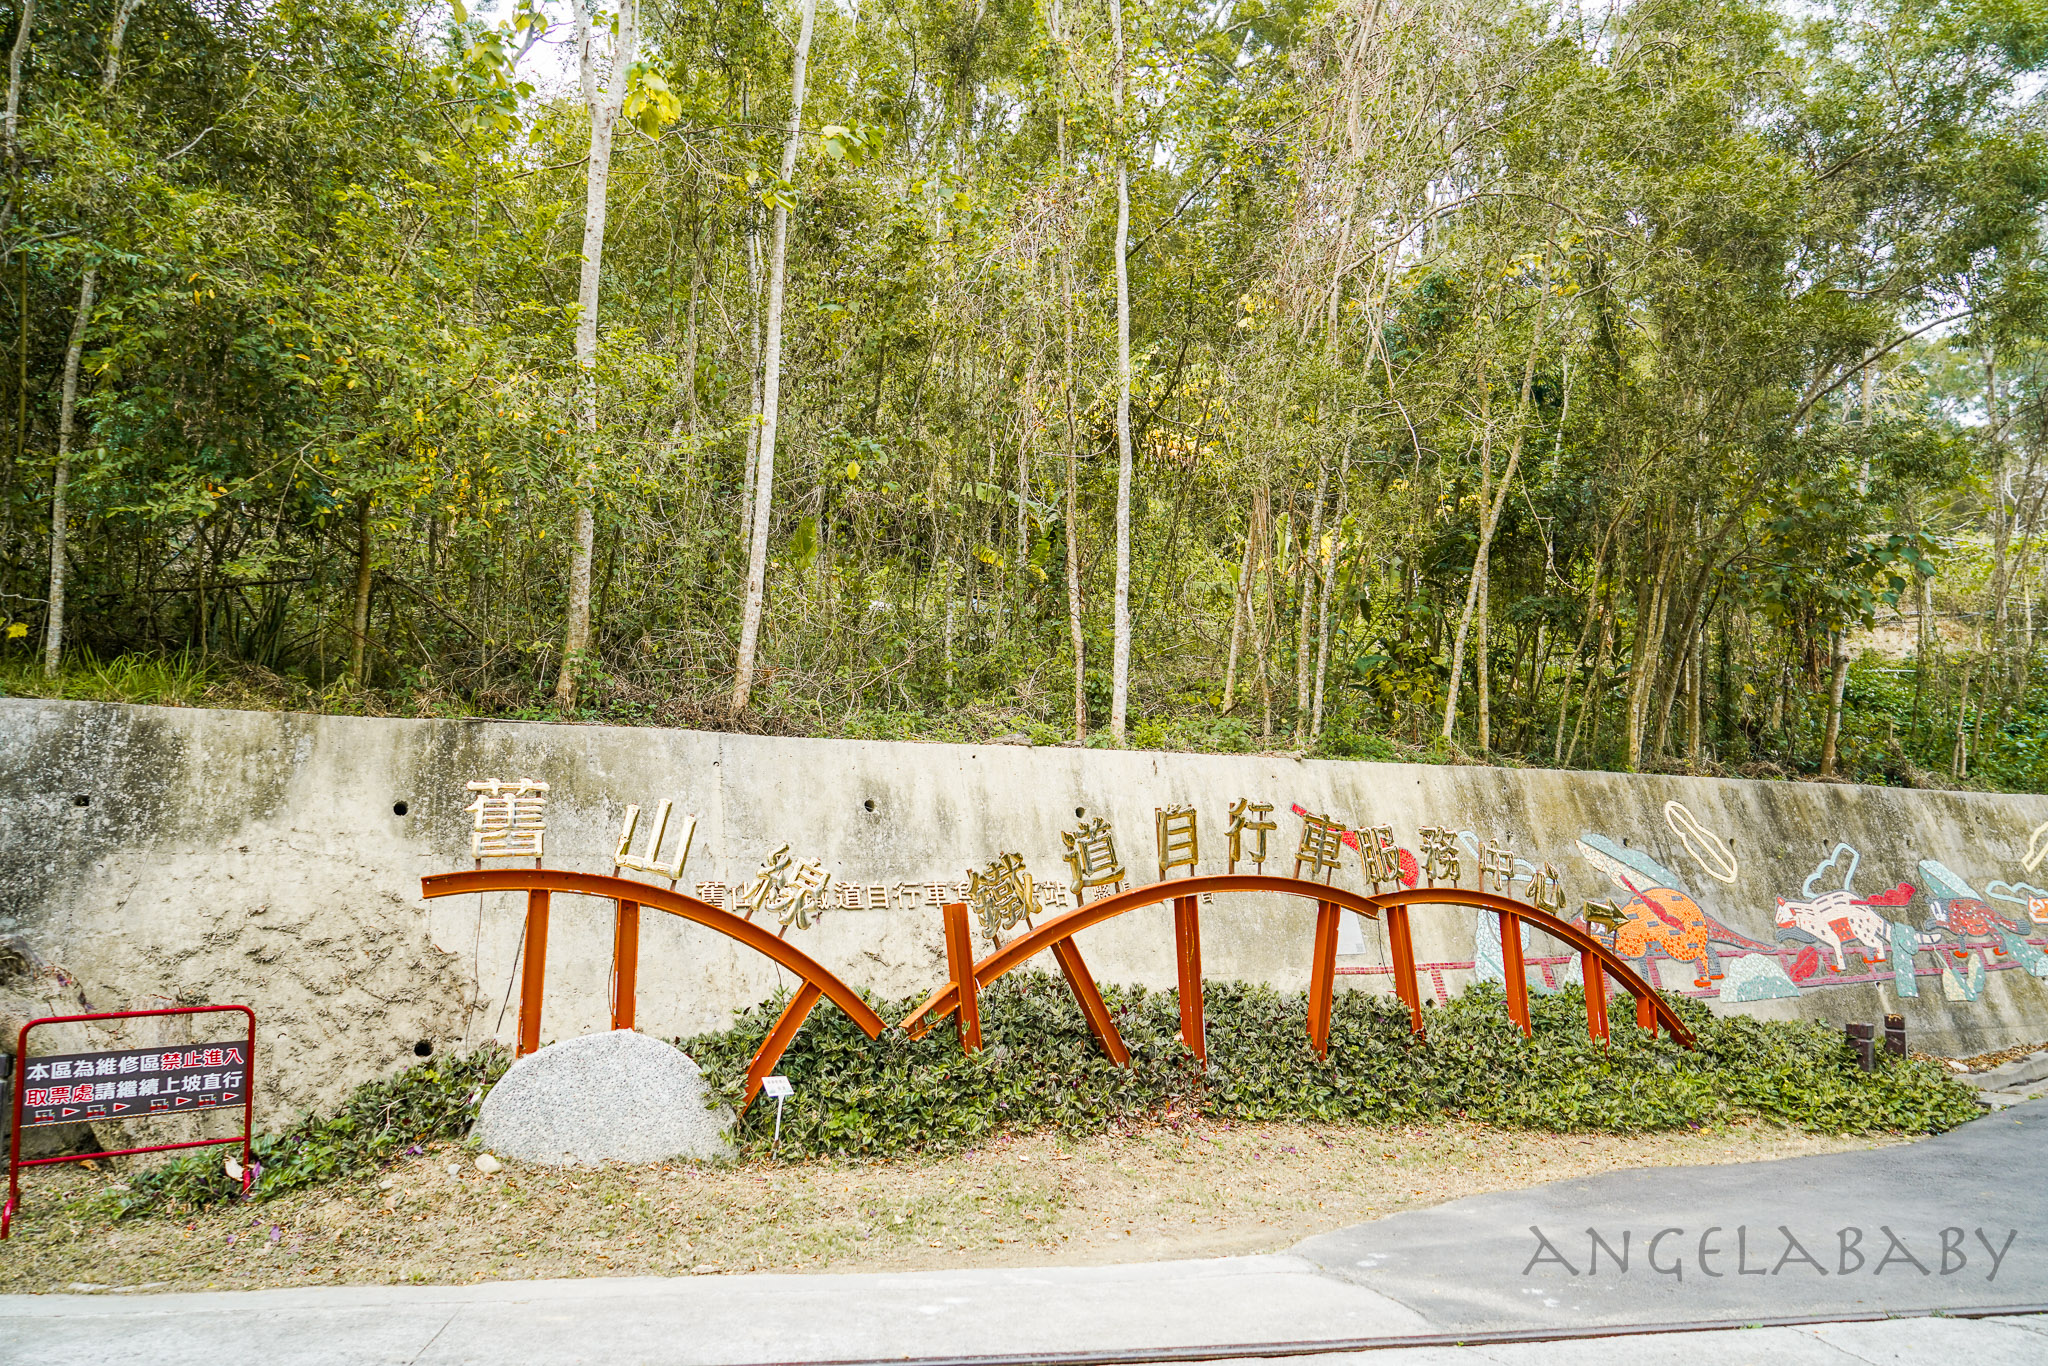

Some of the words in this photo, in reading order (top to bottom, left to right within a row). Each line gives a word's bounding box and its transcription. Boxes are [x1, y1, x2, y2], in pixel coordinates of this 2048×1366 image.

[26, 1047, 245, 1082] 本區為維修區禁止進入
[25, 1070, 244, 1107] 取票處請繼續上坡直行
